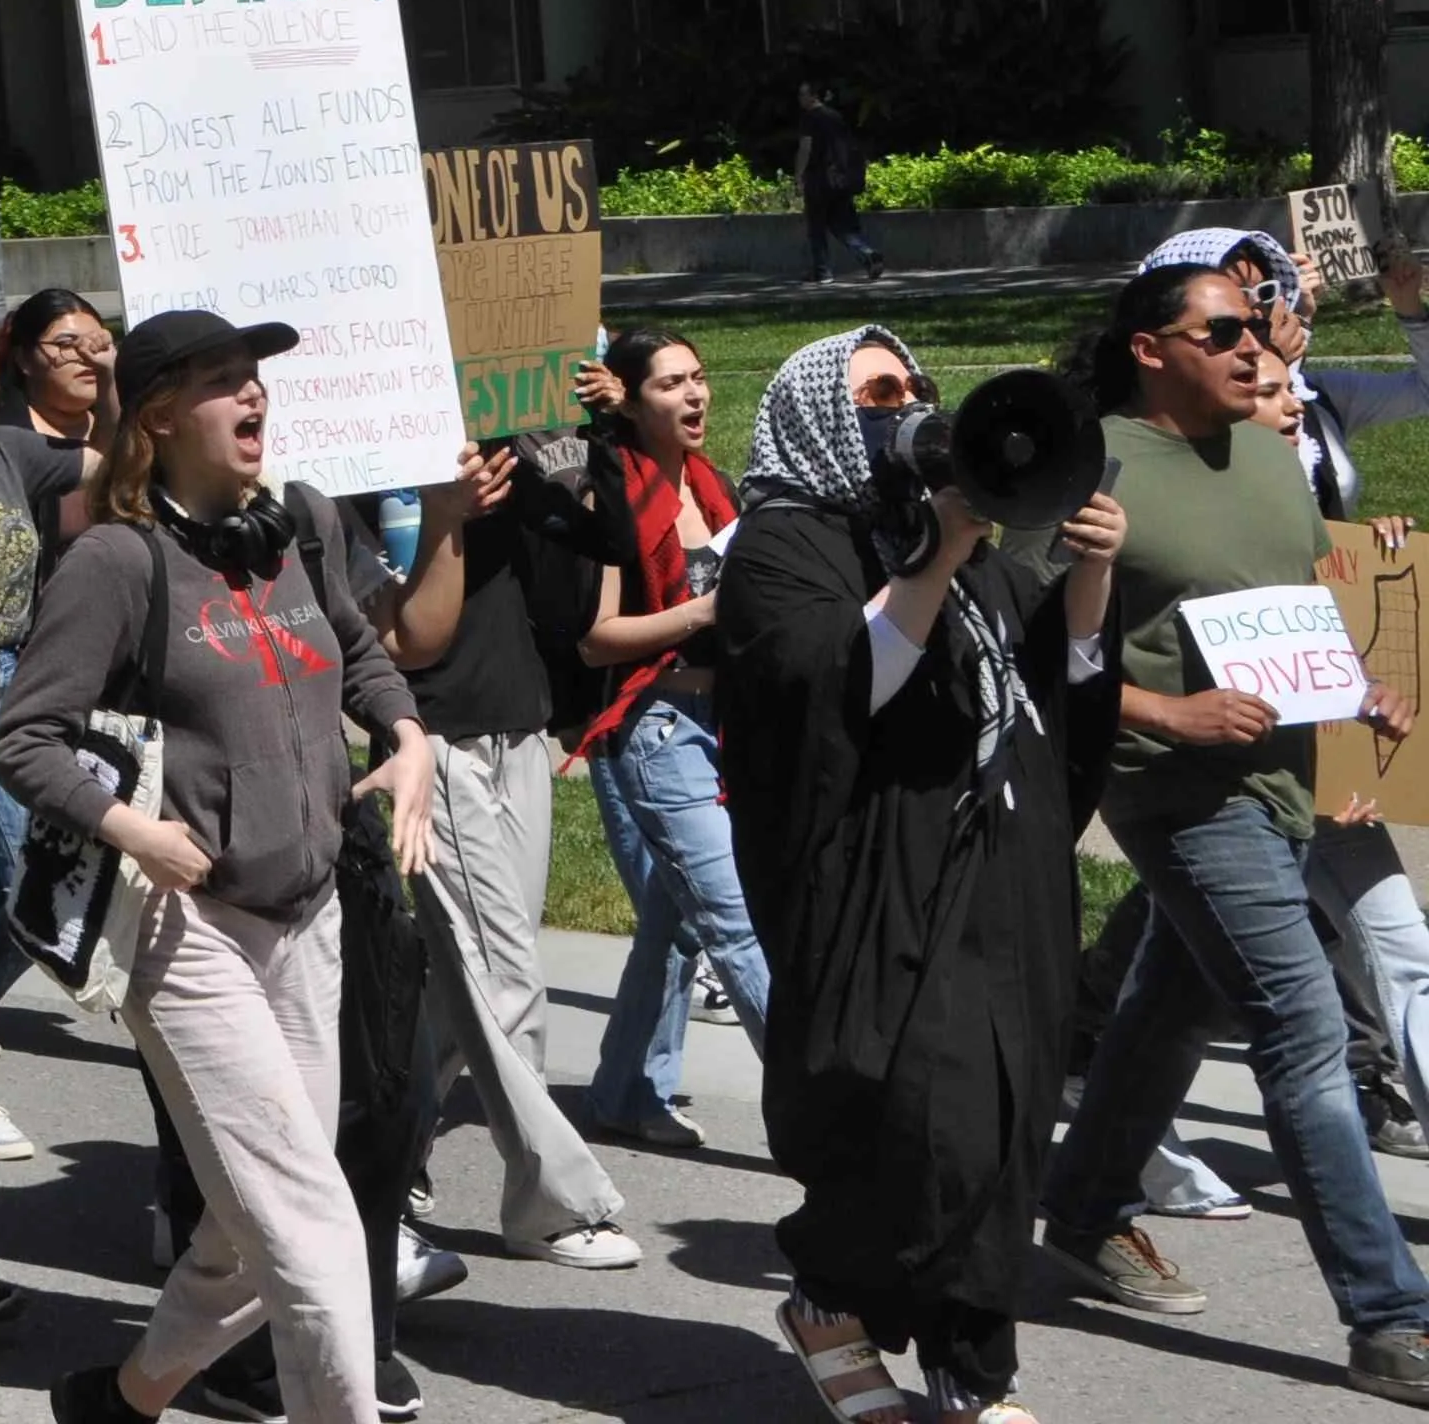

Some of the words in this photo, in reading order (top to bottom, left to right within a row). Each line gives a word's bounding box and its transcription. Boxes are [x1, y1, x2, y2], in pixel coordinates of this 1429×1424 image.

[112, 15, 178, 61] END
[187, 10, 237, 49] THE
[244, 8, 357, 48] SILENCE
[262, 98, 307, 136] ALL
[319, 84, 407, 125] FUNDS
[124, 162, 194, 209] FROM
[205, 160, 248, 197] THE
[487, 149, 520, 238] OF
[531, 146, 589, 232] US
[1303, 184, 1358, 222] STOP
[151, 224, 209, 262] FIRE
[227, 209, 338, 249] JOHNATHAN
[351, 202, 410, 238] ROTH
[496, 237, 573, 300] FREE
[1316, 240, 1389, 284] ENOCIDE
[151, 287, 227, 315] CLEAR
[323, 264, 397, 293] RECORD
[350, 319, 433, 354] FACULTY,
[464, 294, 564, 354] UNTIL
[276, 368, 402, 407] DISCRIMINATION
[410, 364, 448, 392] FOR
[270, 423, 288, 456] &
[291, 417, 382, 451] SPEAKING
[388, 410, 450, 439] ABOUT
[185, 619, 246, 643] CALVIN
[1201, 605, 1344, 646] DISCLOSE
[1223, 650, 1361, 696] DIVEST
